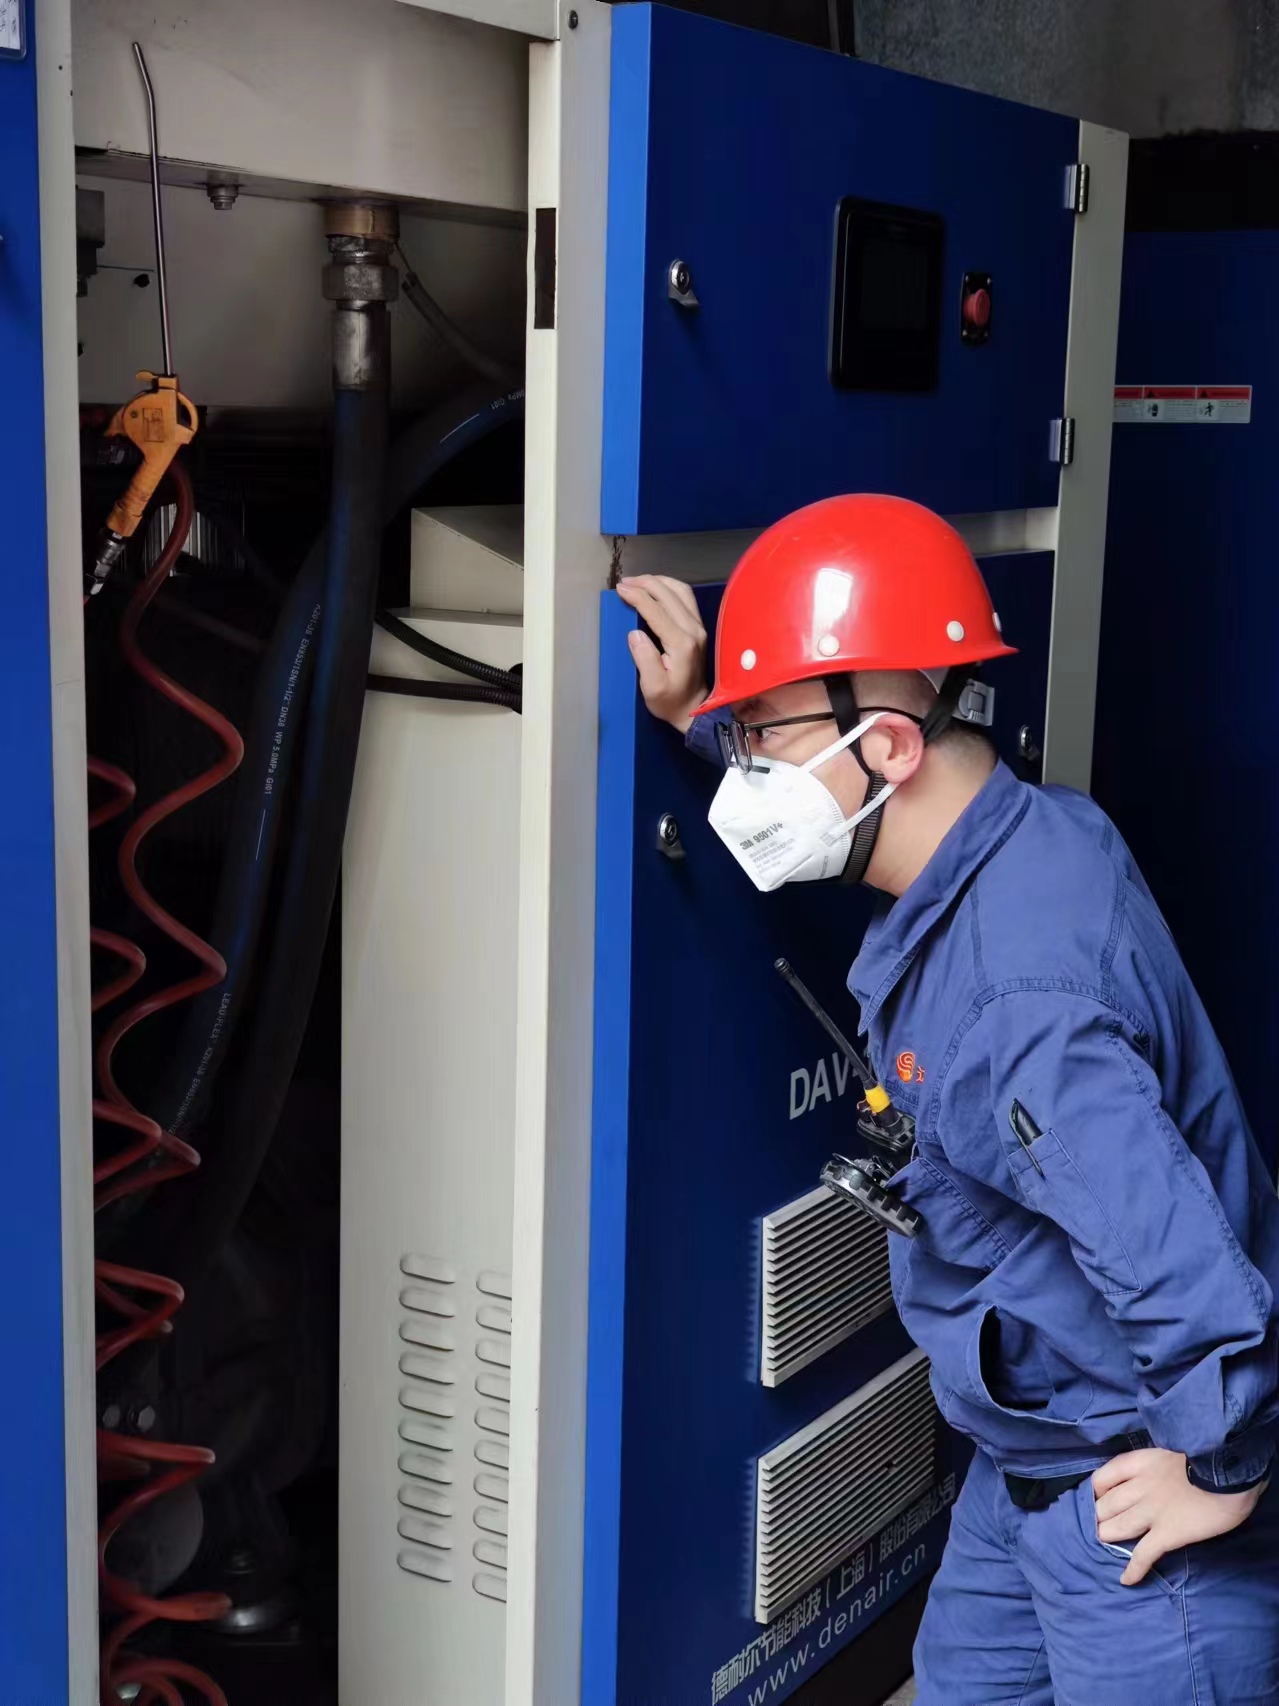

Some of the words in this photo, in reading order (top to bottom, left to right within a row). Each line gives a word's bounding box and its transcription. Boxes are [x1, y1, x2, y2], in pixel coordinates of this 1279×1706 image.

[277, 706, 289, 728] DN38
[274, 731, 284, 744] WP
[739, 839, 754, 851] 3M
[753, 822, 784, 844] 9501V+
[747, 1543, 926, 1706] www.denair.cn
